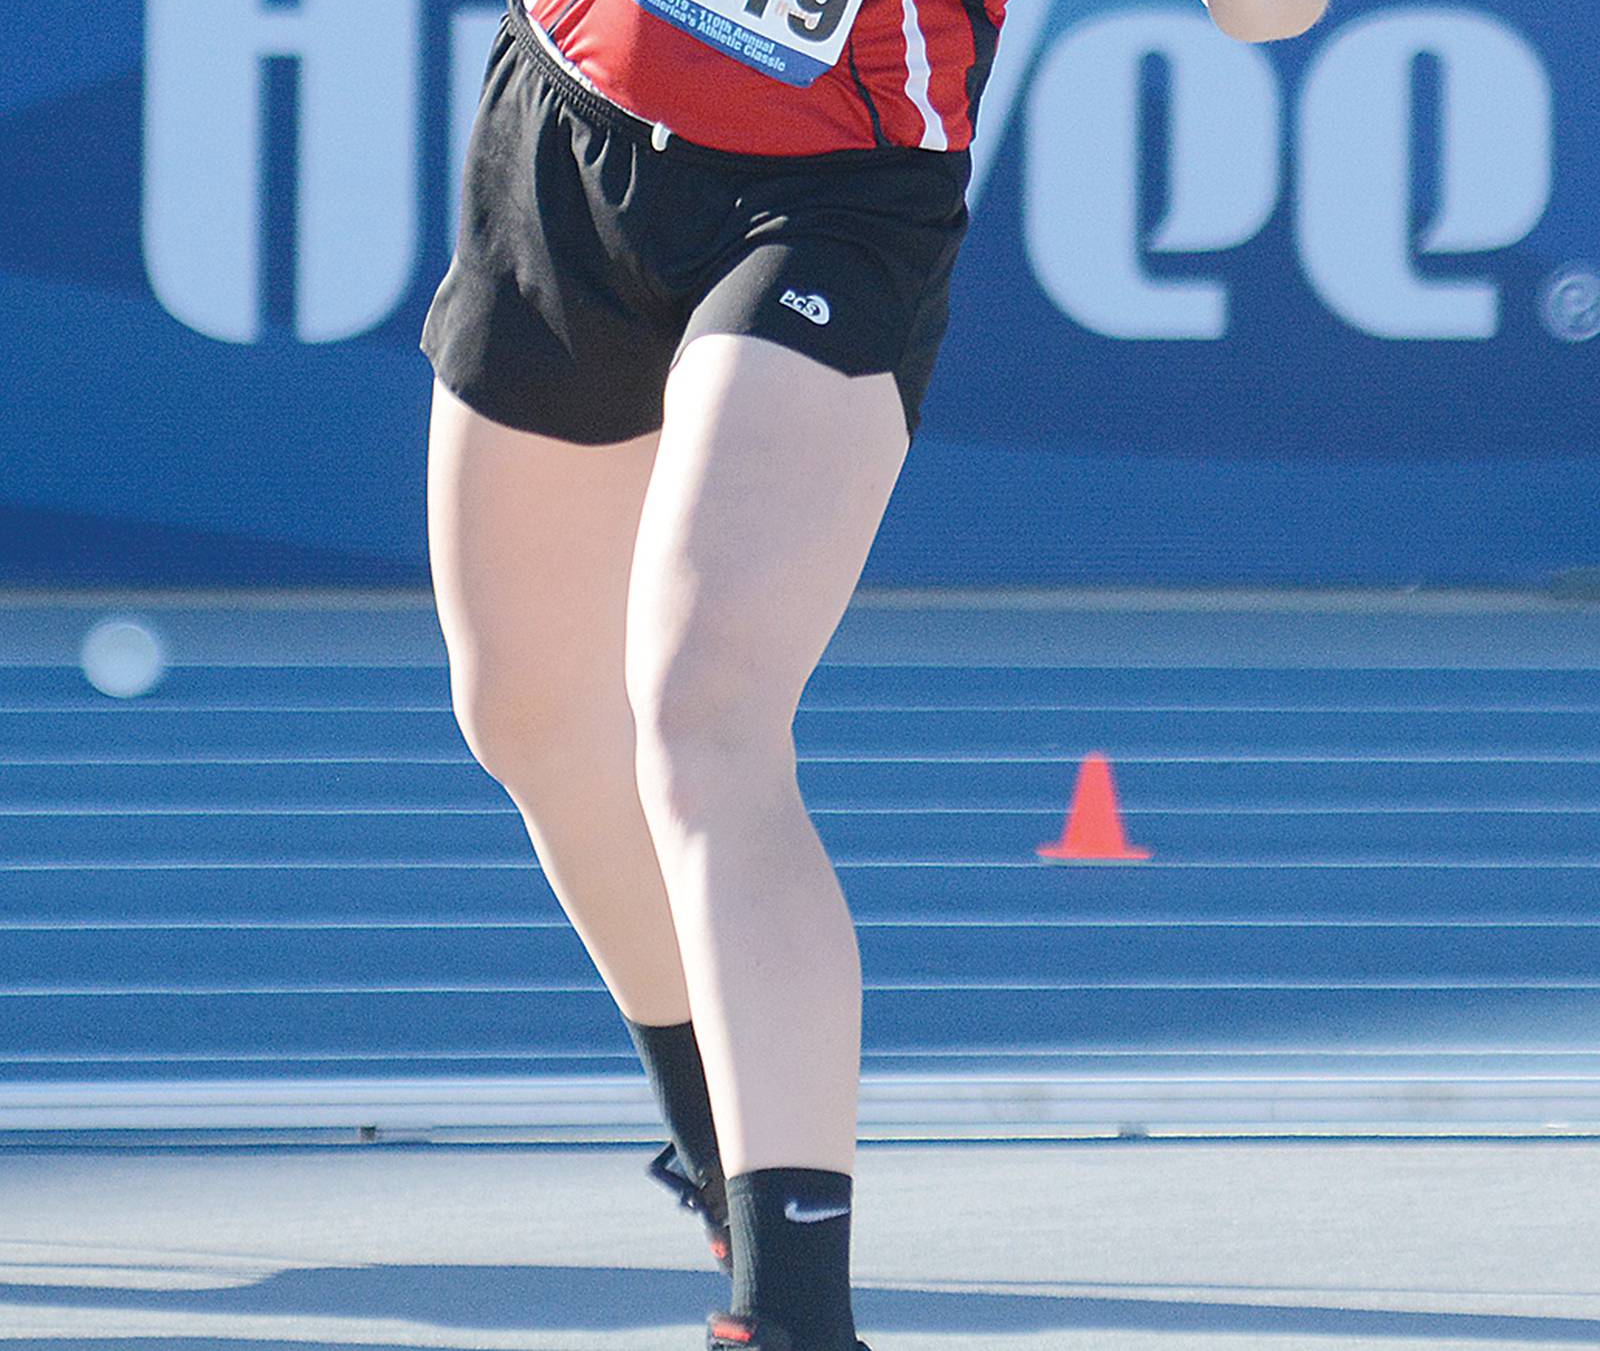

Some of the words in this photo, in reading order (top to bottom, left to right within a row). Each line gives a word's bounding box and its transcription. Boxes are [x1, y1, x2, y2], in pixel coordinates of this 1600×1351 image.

[697, 21, 743, 50] Athletic
[743, 45, 786, 72] Classic
[700, 9, 732, 34] 110th
[733, 27, 775, 54] Annual
[780, 290, 818, 318] PCS
